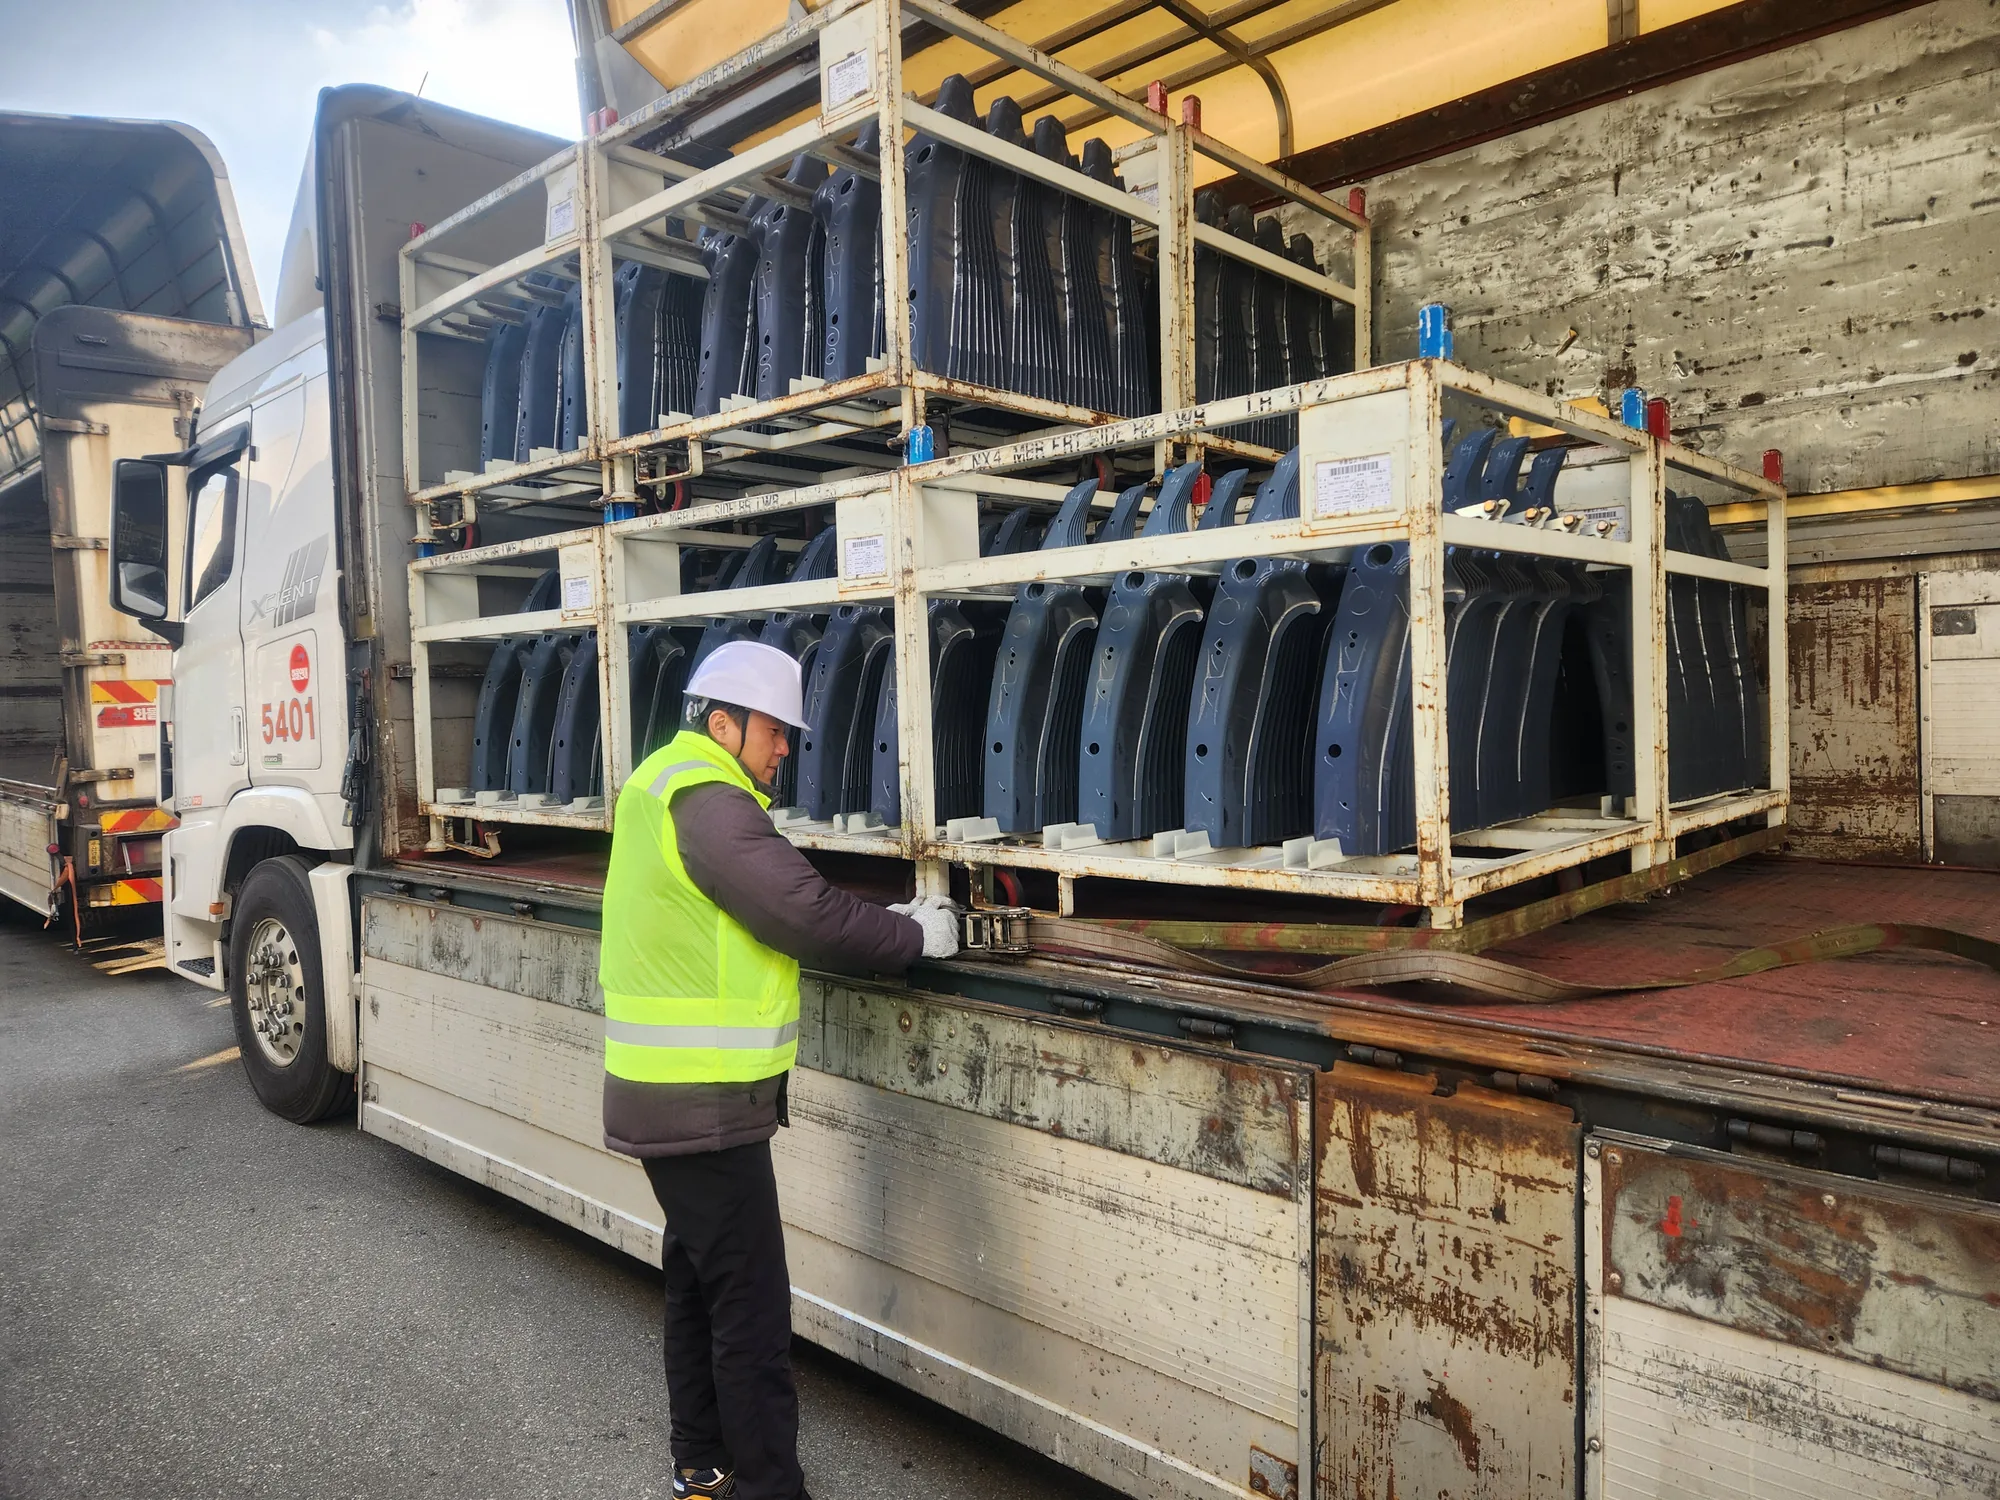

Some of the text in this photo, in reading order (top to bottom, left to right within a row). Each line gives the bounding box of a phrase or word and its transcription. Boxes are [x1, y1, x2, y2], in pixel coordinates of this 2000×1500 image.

[972, 449, 1002, 470] NX4
[248, 575, 319, 625] XCIENT
[262, 696, 316, 745] 5401
